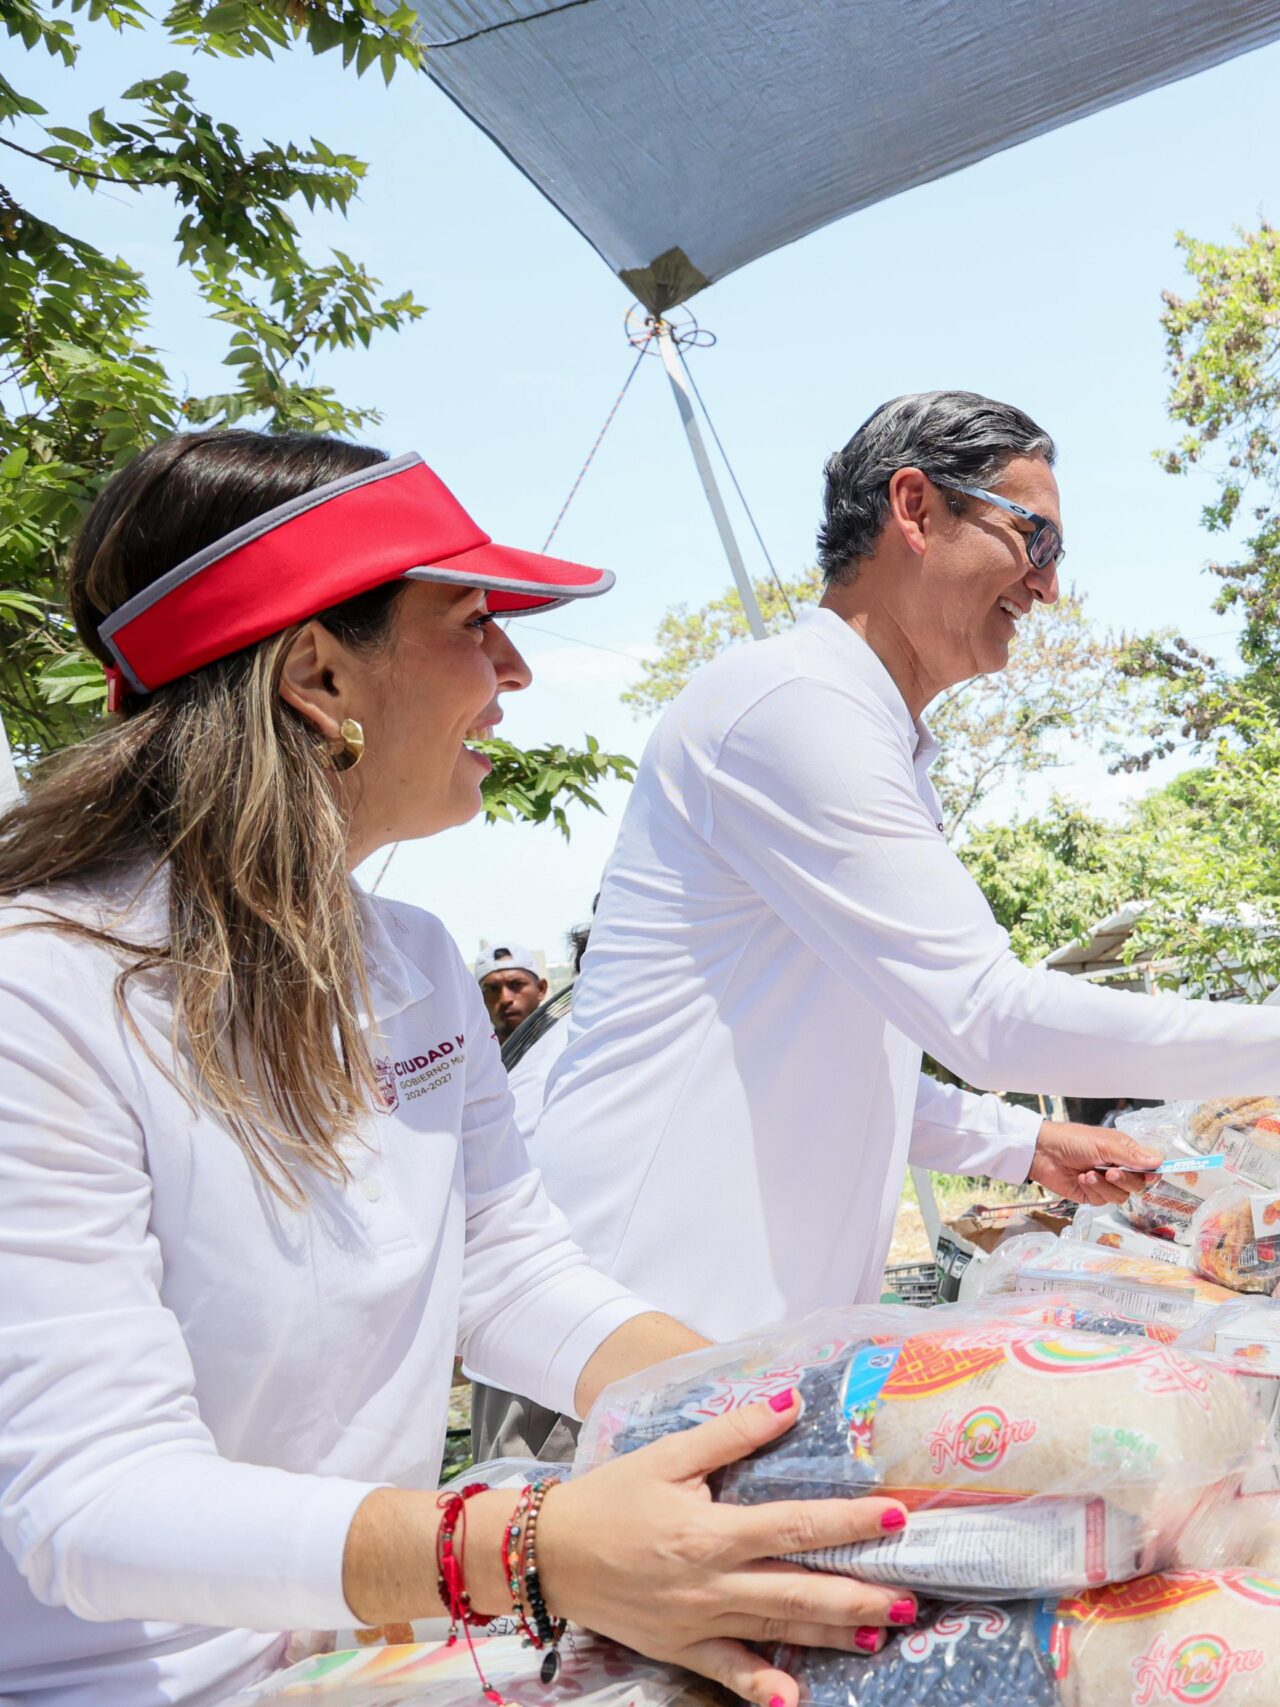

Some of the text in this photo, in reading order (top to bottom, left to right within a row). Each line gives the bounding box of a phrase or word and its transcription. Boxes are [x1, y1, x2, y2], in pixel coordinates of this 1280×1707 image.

[394, 1041, 455, 1076] CIUDAD
[399, 1062, 450, 1090] GOBIERNO
[405, 1073, 452, 1101] 2024-2027
[930, 1419, 1037, 1475] Nuestra
[1135, 1649, 1264, 1705] Nuestra
